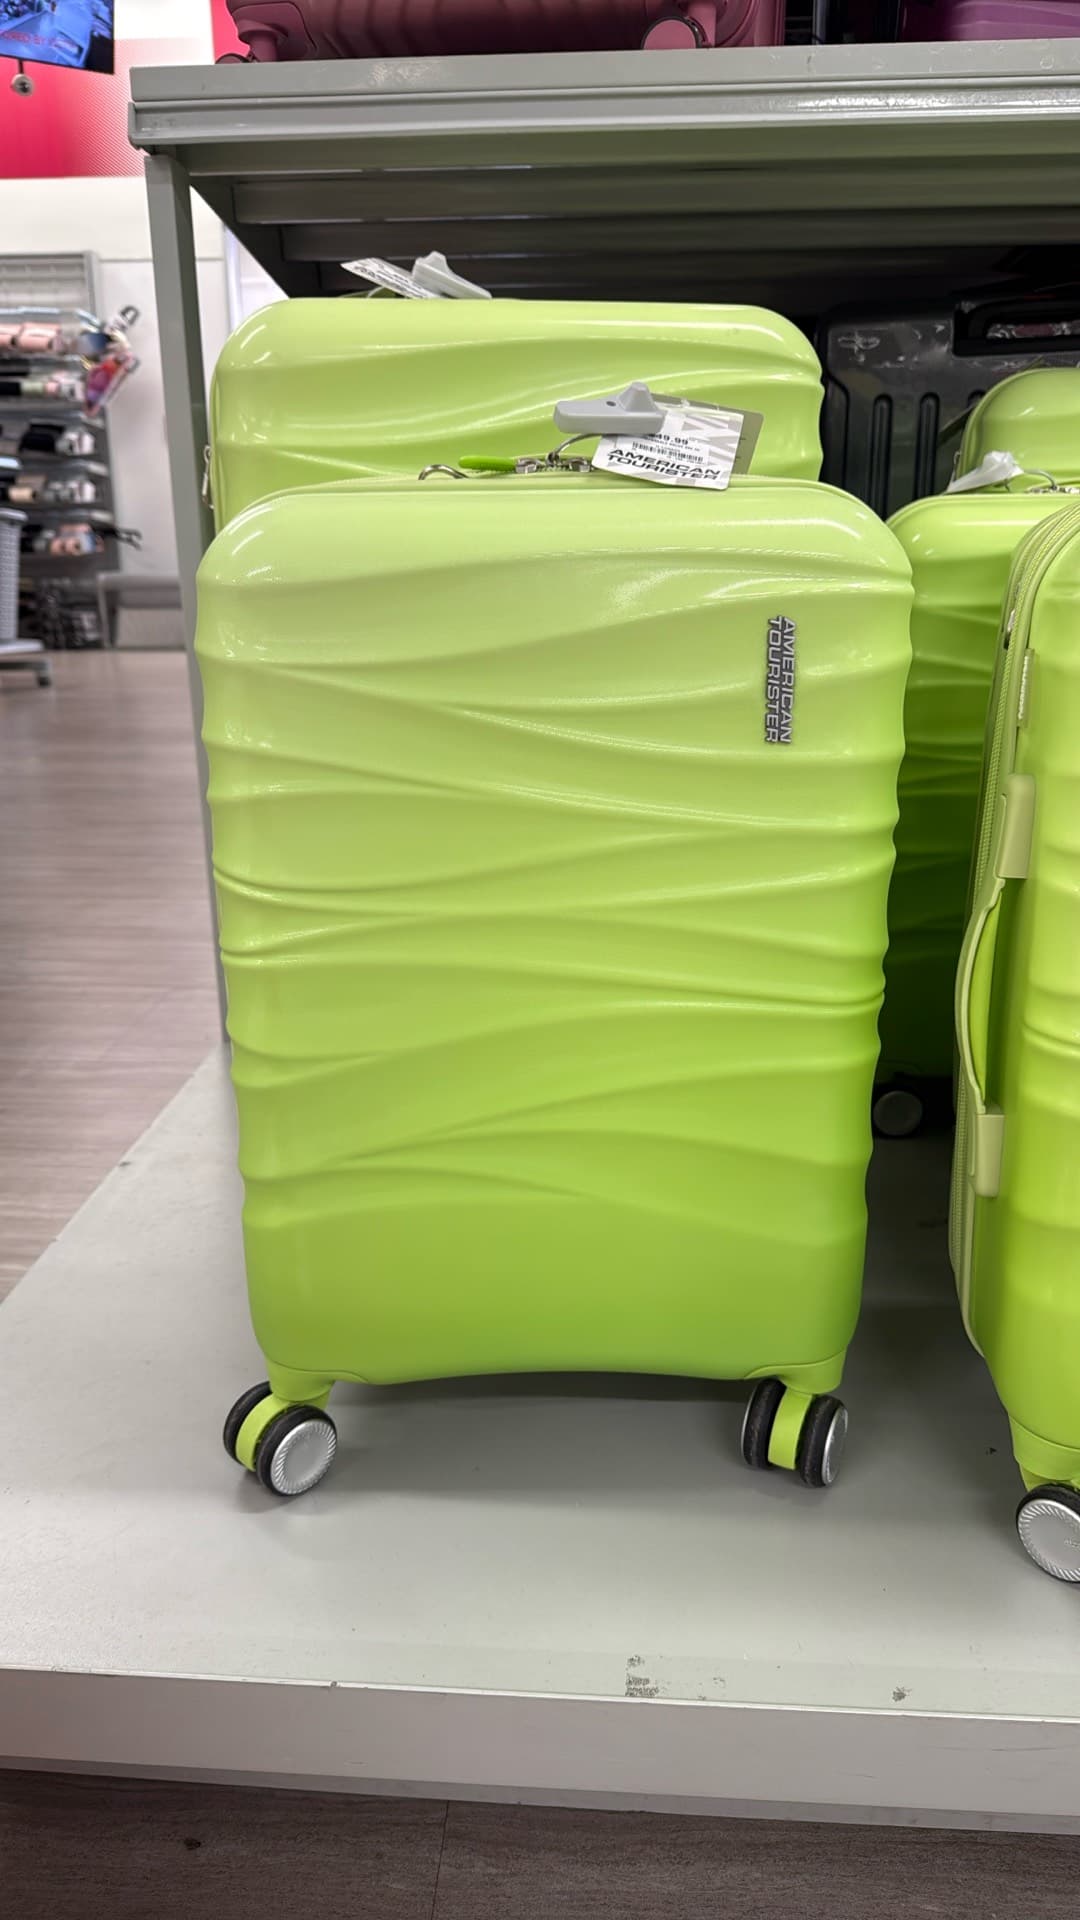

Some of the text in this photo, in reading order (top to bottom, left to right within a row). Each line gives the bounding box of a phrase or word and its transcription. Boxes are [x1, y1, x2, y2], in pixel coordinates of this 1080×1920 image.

[607, 454, 718, 480] TOURISTER
[610, 449, 721, 475] AMERICAN
[766, 615, 782, 743] TOURISTER
[780, 617, 796, 743] AMERICAN
